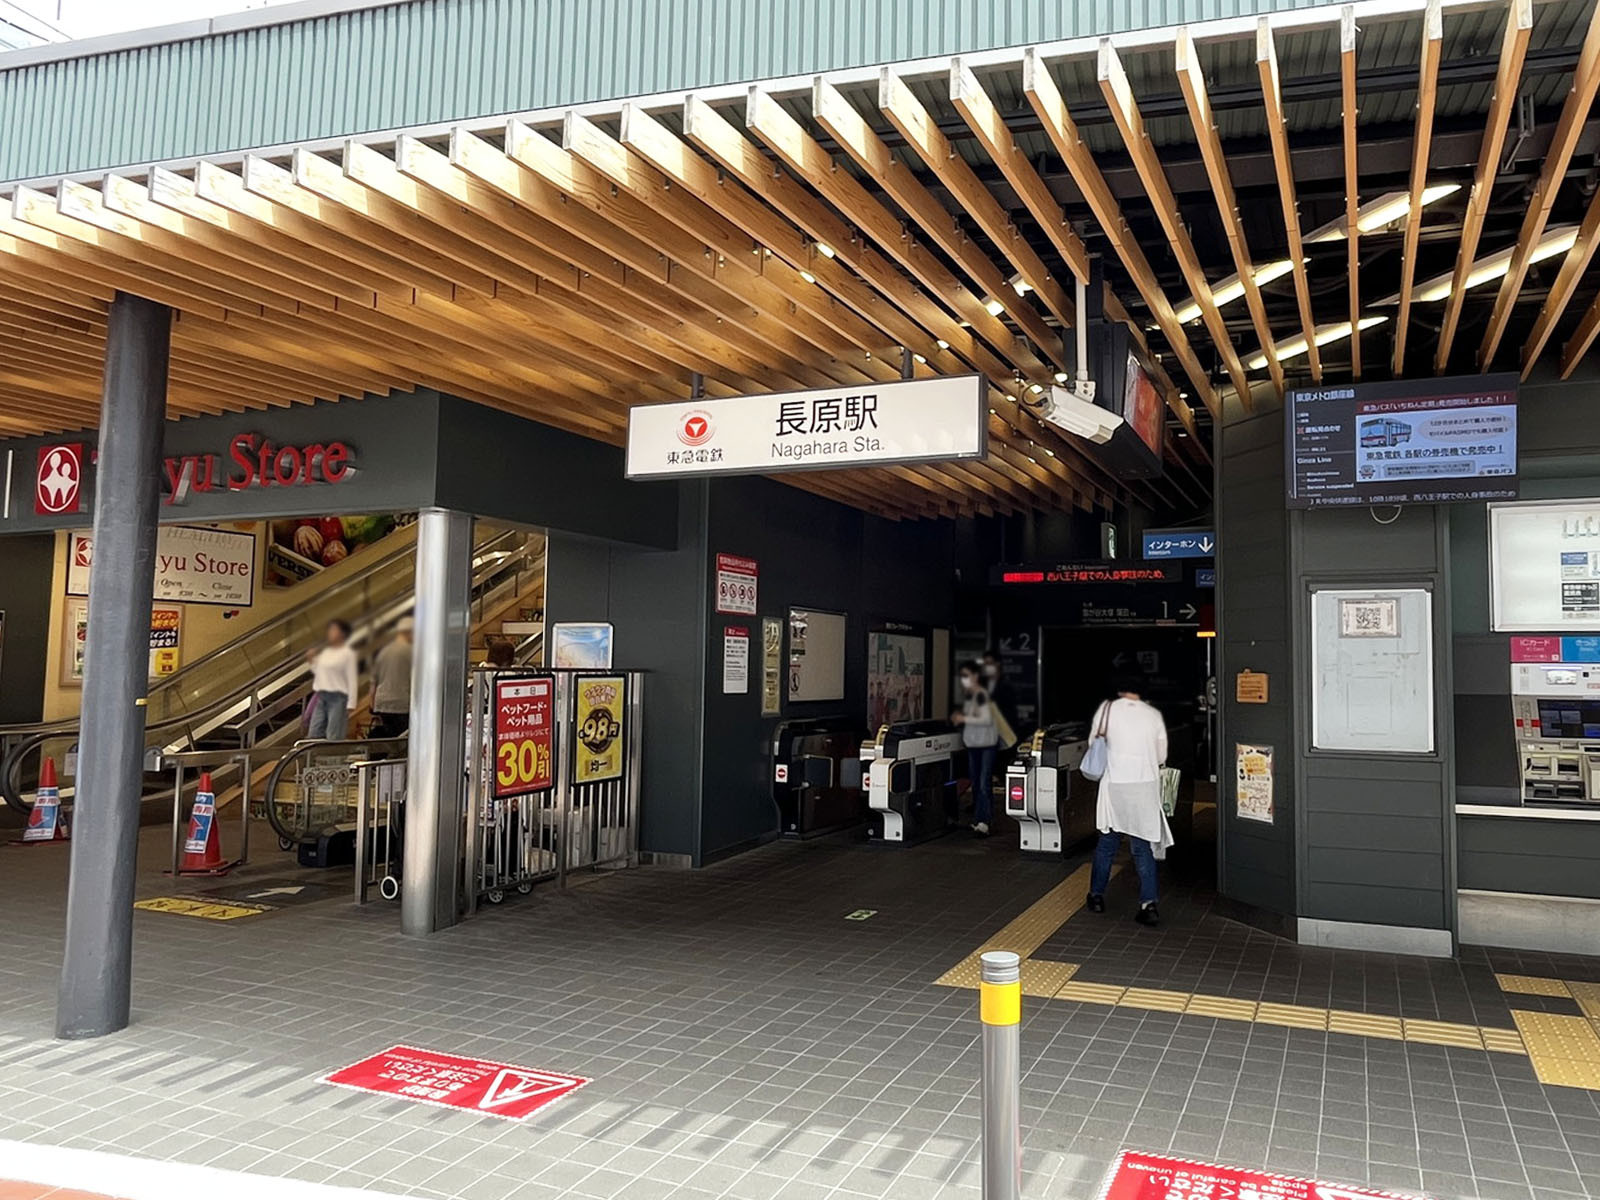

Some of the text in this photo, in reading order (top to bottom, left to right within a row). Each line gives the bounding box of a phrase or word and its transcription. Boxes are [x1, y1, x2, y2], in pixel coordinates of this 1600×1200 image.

[776, 394, 878, 437] 長原駅
[771, 436, 885, 460] Nagahara Sta.
[227, 433, 348, 489] Store
[667, 448, 724, 464] 東急電鉄
[1149, 540, 1196, 550] インターホン
[194, 552, 249, 577] Store
[1127, 1162, 1173, 1174] uneven
[1191, 1174, 1235, 1186] careful
[1239, 1181, 1257, 1190] be
[1261, 1184, 1308, 1198] Please
